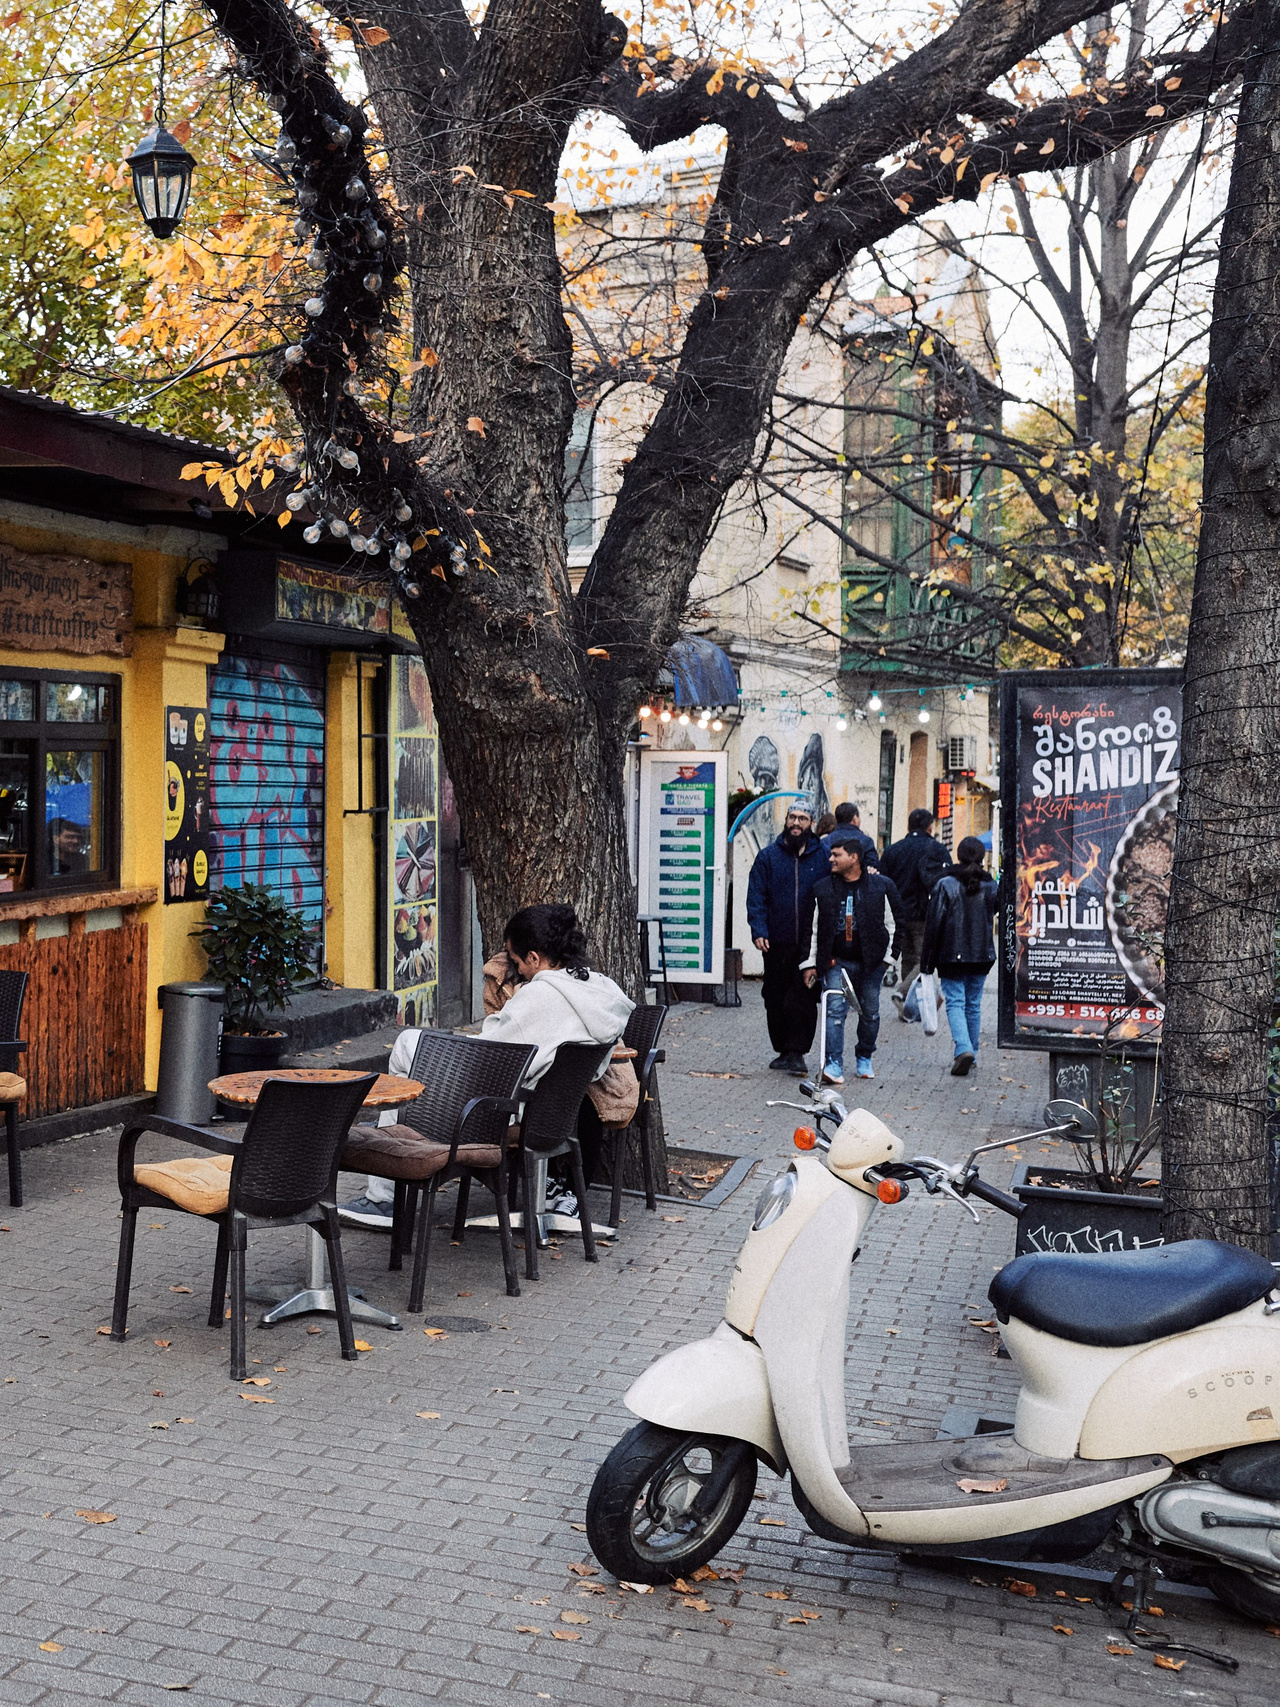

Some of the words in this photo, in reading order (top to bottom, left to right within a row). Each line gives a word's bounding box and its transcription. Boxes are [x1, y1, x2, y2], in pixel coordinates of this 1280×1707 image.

[1032, 703, 1115, 726] რესტორანი
[1033, 706, 1177, 757] შანდიზ
[1032, 740, 1179, 798] SHANDIZ
[1034, 794, 1123, 821] Restaurant
[1032, 878, 1077, 896] مطعم
[1028, 1004, 1065, 1017] +995
[1080, 1006, 1108, 1019] 514
